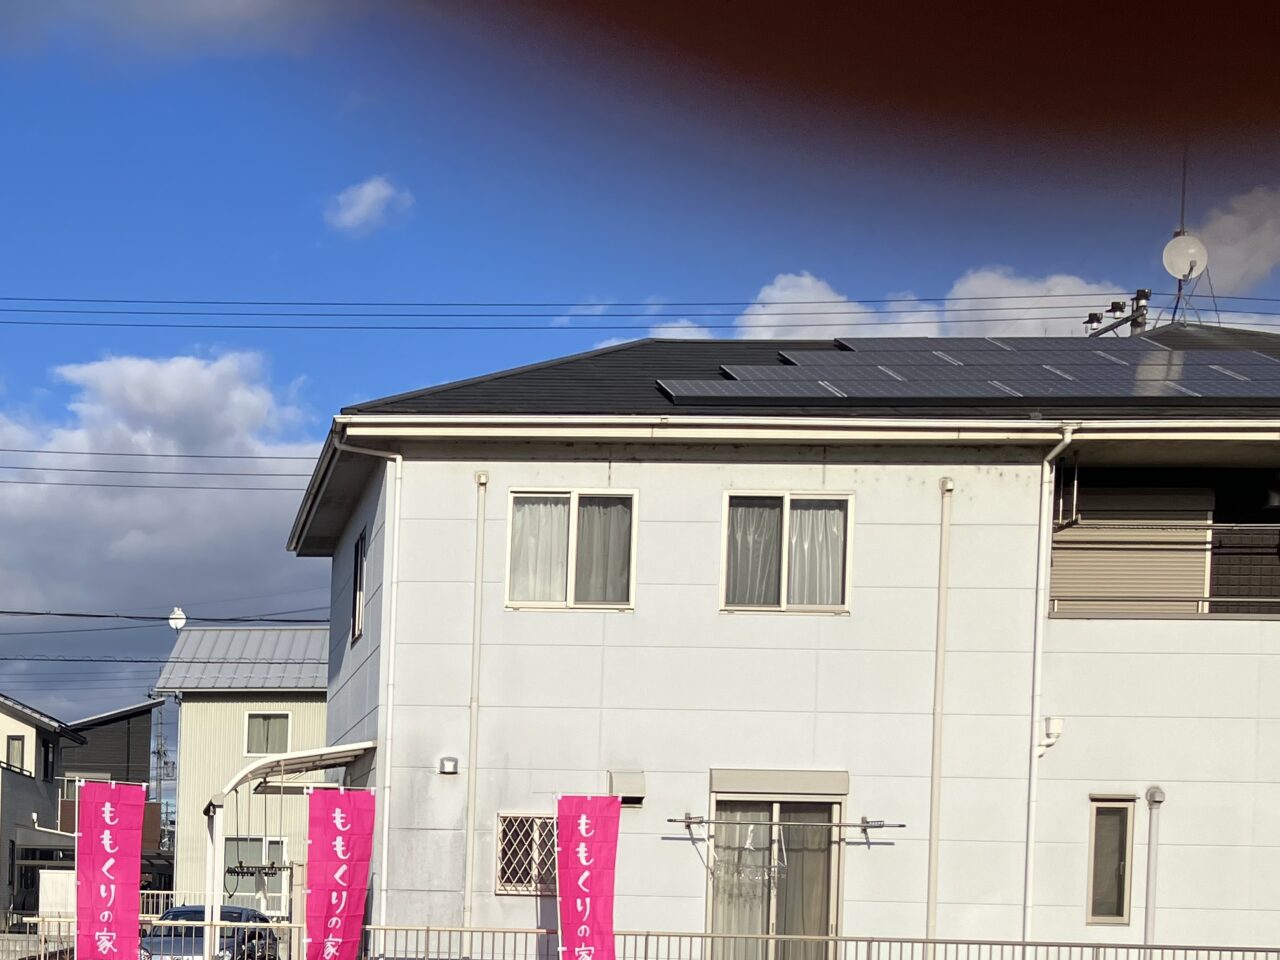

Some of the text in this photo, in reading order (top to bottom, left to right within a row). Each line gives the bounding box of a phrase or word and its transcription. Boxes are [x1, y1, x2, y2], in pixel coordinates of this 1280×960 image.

[95, 802, 119, 954] ももくりの家
[323, 807, 352, 960] ももくりの家
